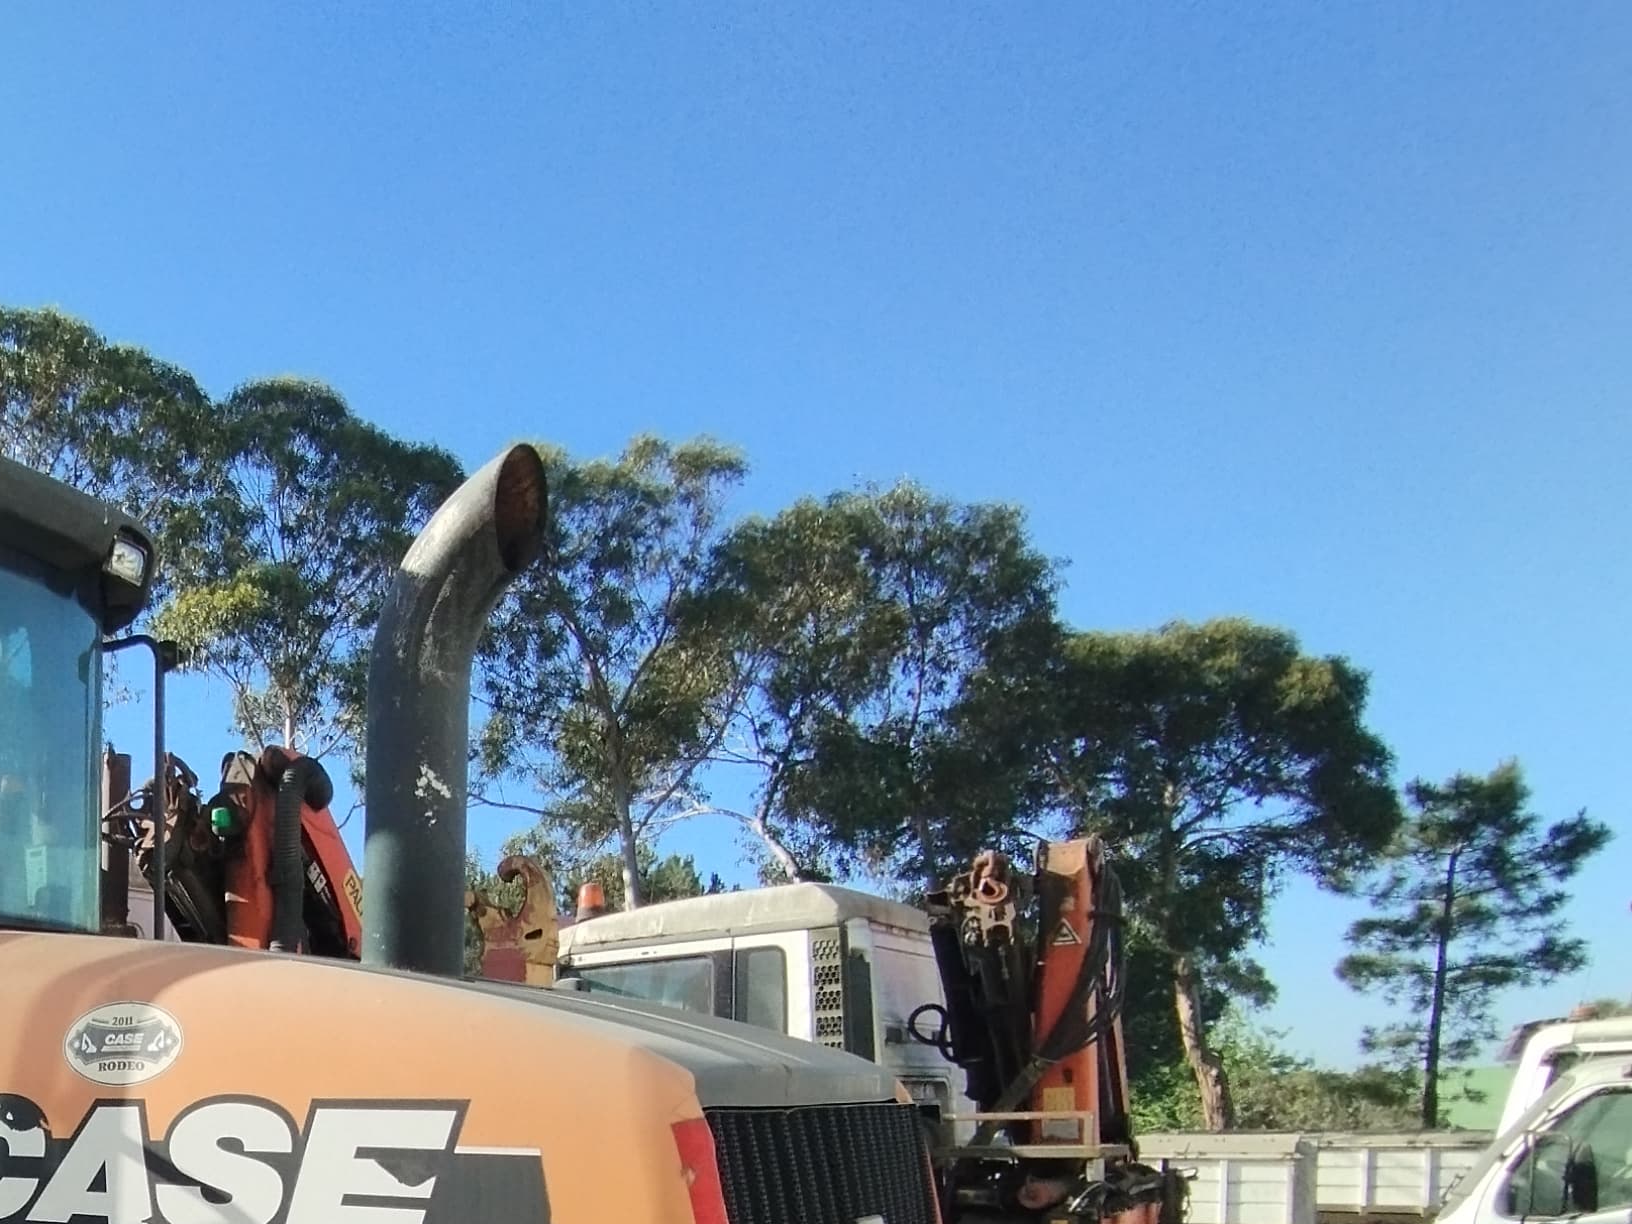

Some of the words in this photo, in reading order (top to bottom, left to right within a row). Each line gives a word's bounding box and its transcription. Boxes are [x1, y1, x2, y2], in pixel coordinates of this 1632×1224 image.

[345, 875, 363, 916] PAL
[112, 1016, 134, 1026] 2011
[104, 1033, 145, 1045] CASE
[98, 1061, 145, 1072] RODEO
